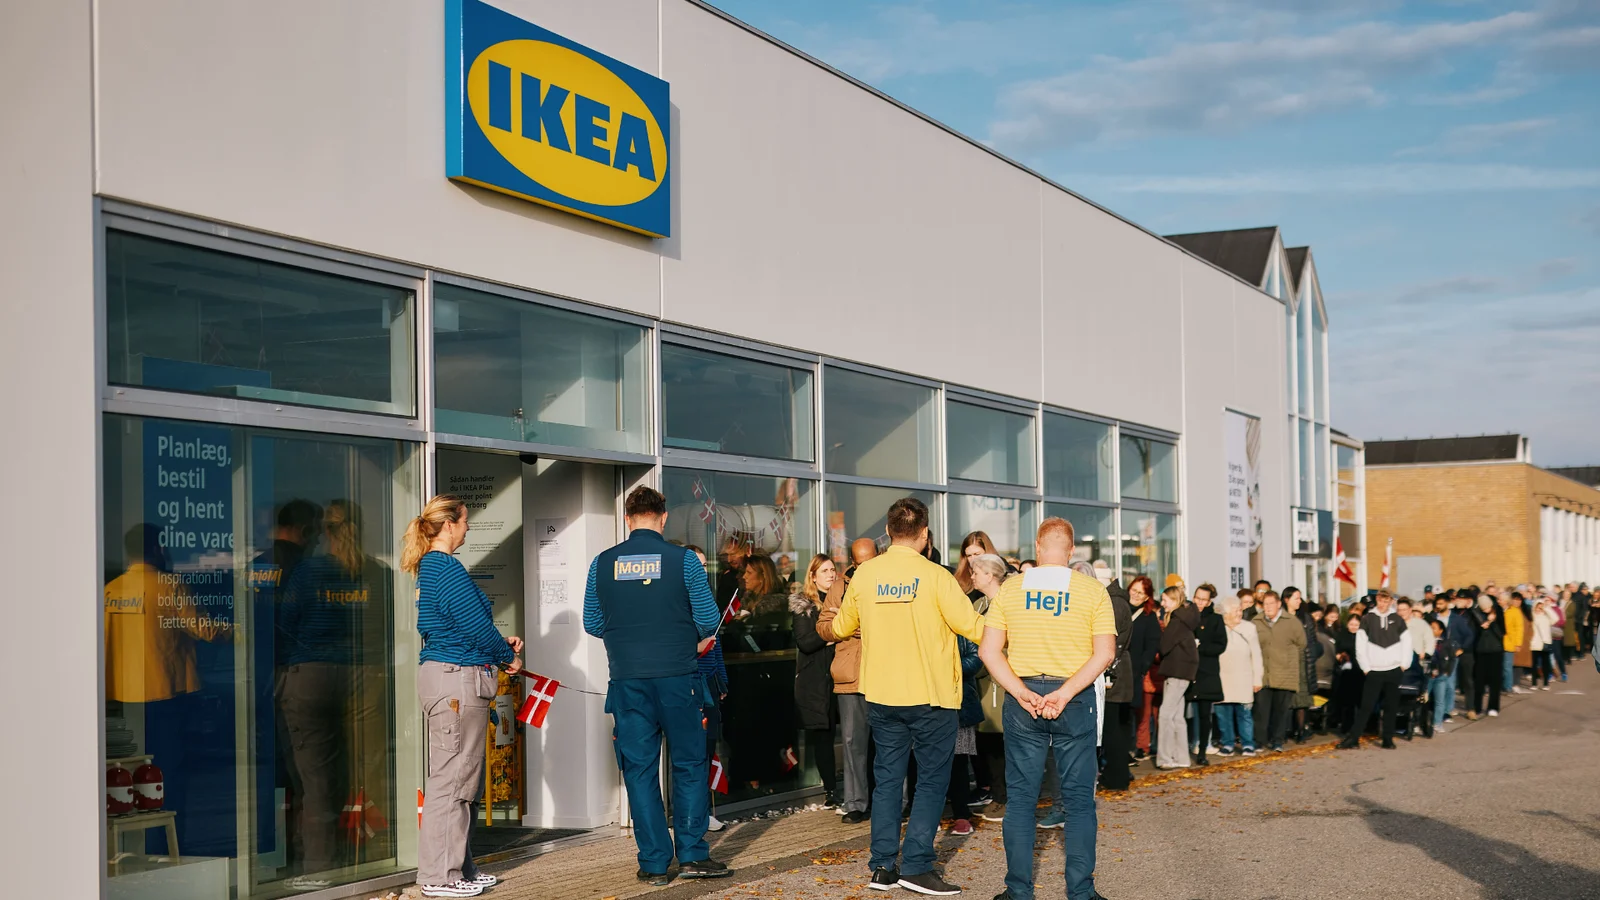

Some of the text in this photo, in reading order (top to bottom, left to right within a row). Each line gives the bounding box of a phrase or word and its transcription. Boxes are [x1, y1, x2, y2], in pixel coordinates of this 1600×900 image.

[488, 59, 657, 183] IKEA
[158, 435, 232, 467] Planlæg,
[158, 465, 205, 489] bestil
[475, 492, 493, 501] point
[158, 496, 225, 524] og hent
[158, 525, 197, 548] dine
[157, 570, 223, 588] Inspiration til
[618, 560, 661, 577] Mojn!
[157, 592, 234, 610] boligindretning
[877, 582, 916, 599] Mojn!
[1026, 591, 1070, 616] Hej!
[157, 612, 232, 631] Tættere på dig.
